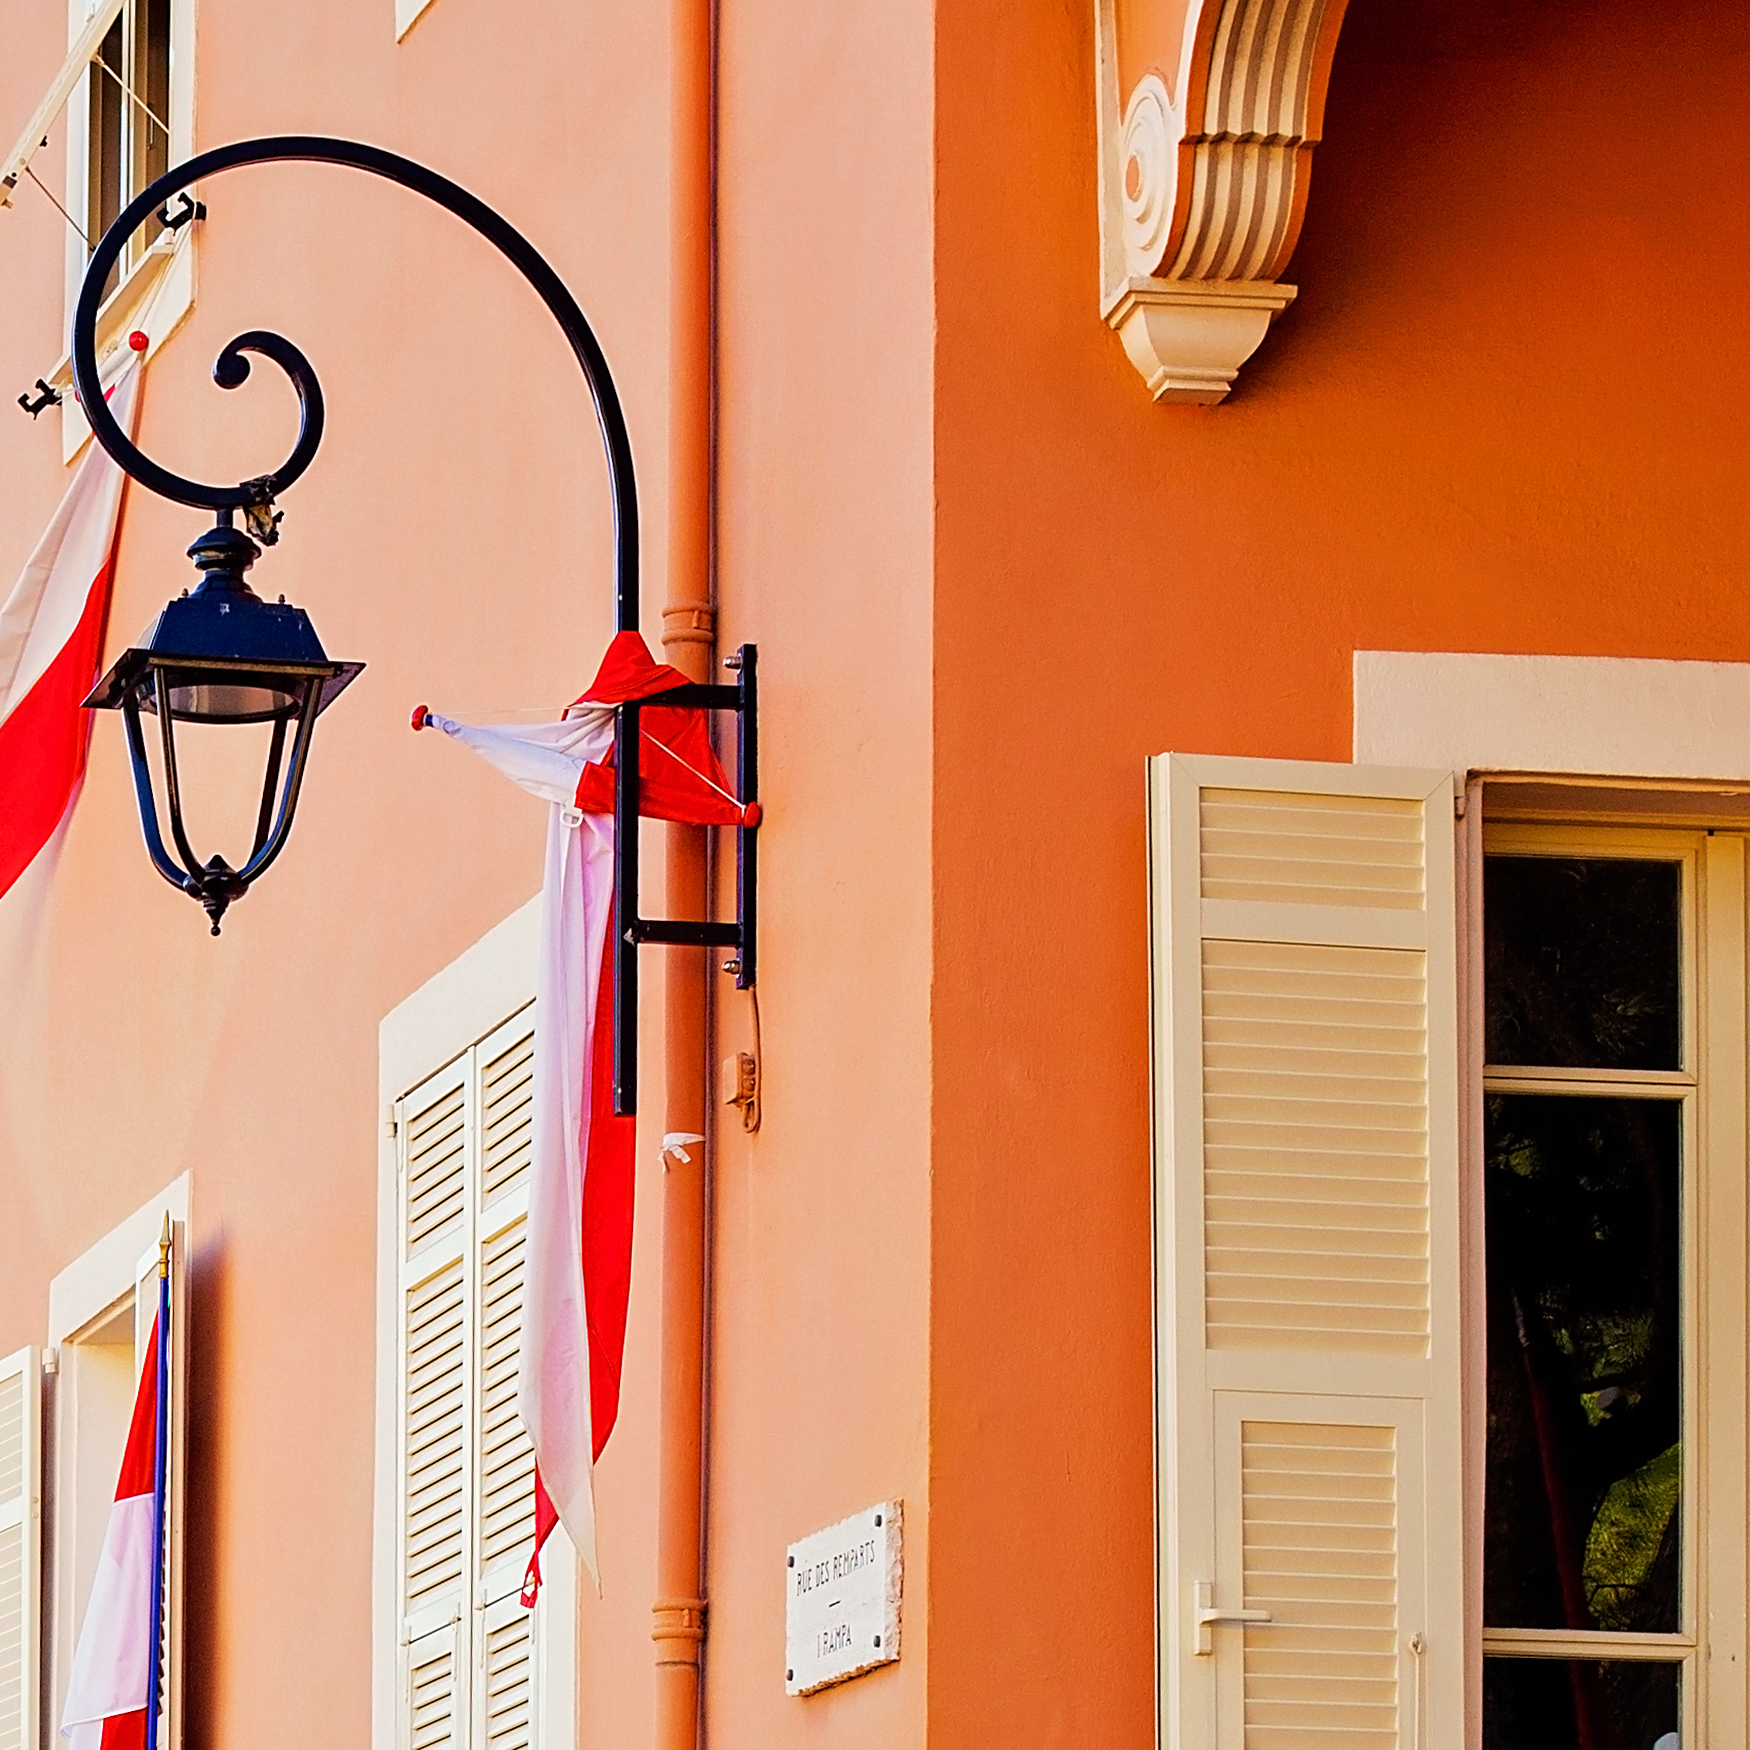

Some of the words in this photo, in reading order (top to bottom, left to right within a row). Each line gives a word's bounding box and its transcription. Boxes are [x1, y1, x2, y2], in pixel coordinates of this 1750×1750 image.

[796, 1568, 812, 1597] RUE
[815, 1560, 830, 1588] DES
[832, 1539, 875, 1580] REMPARTS
